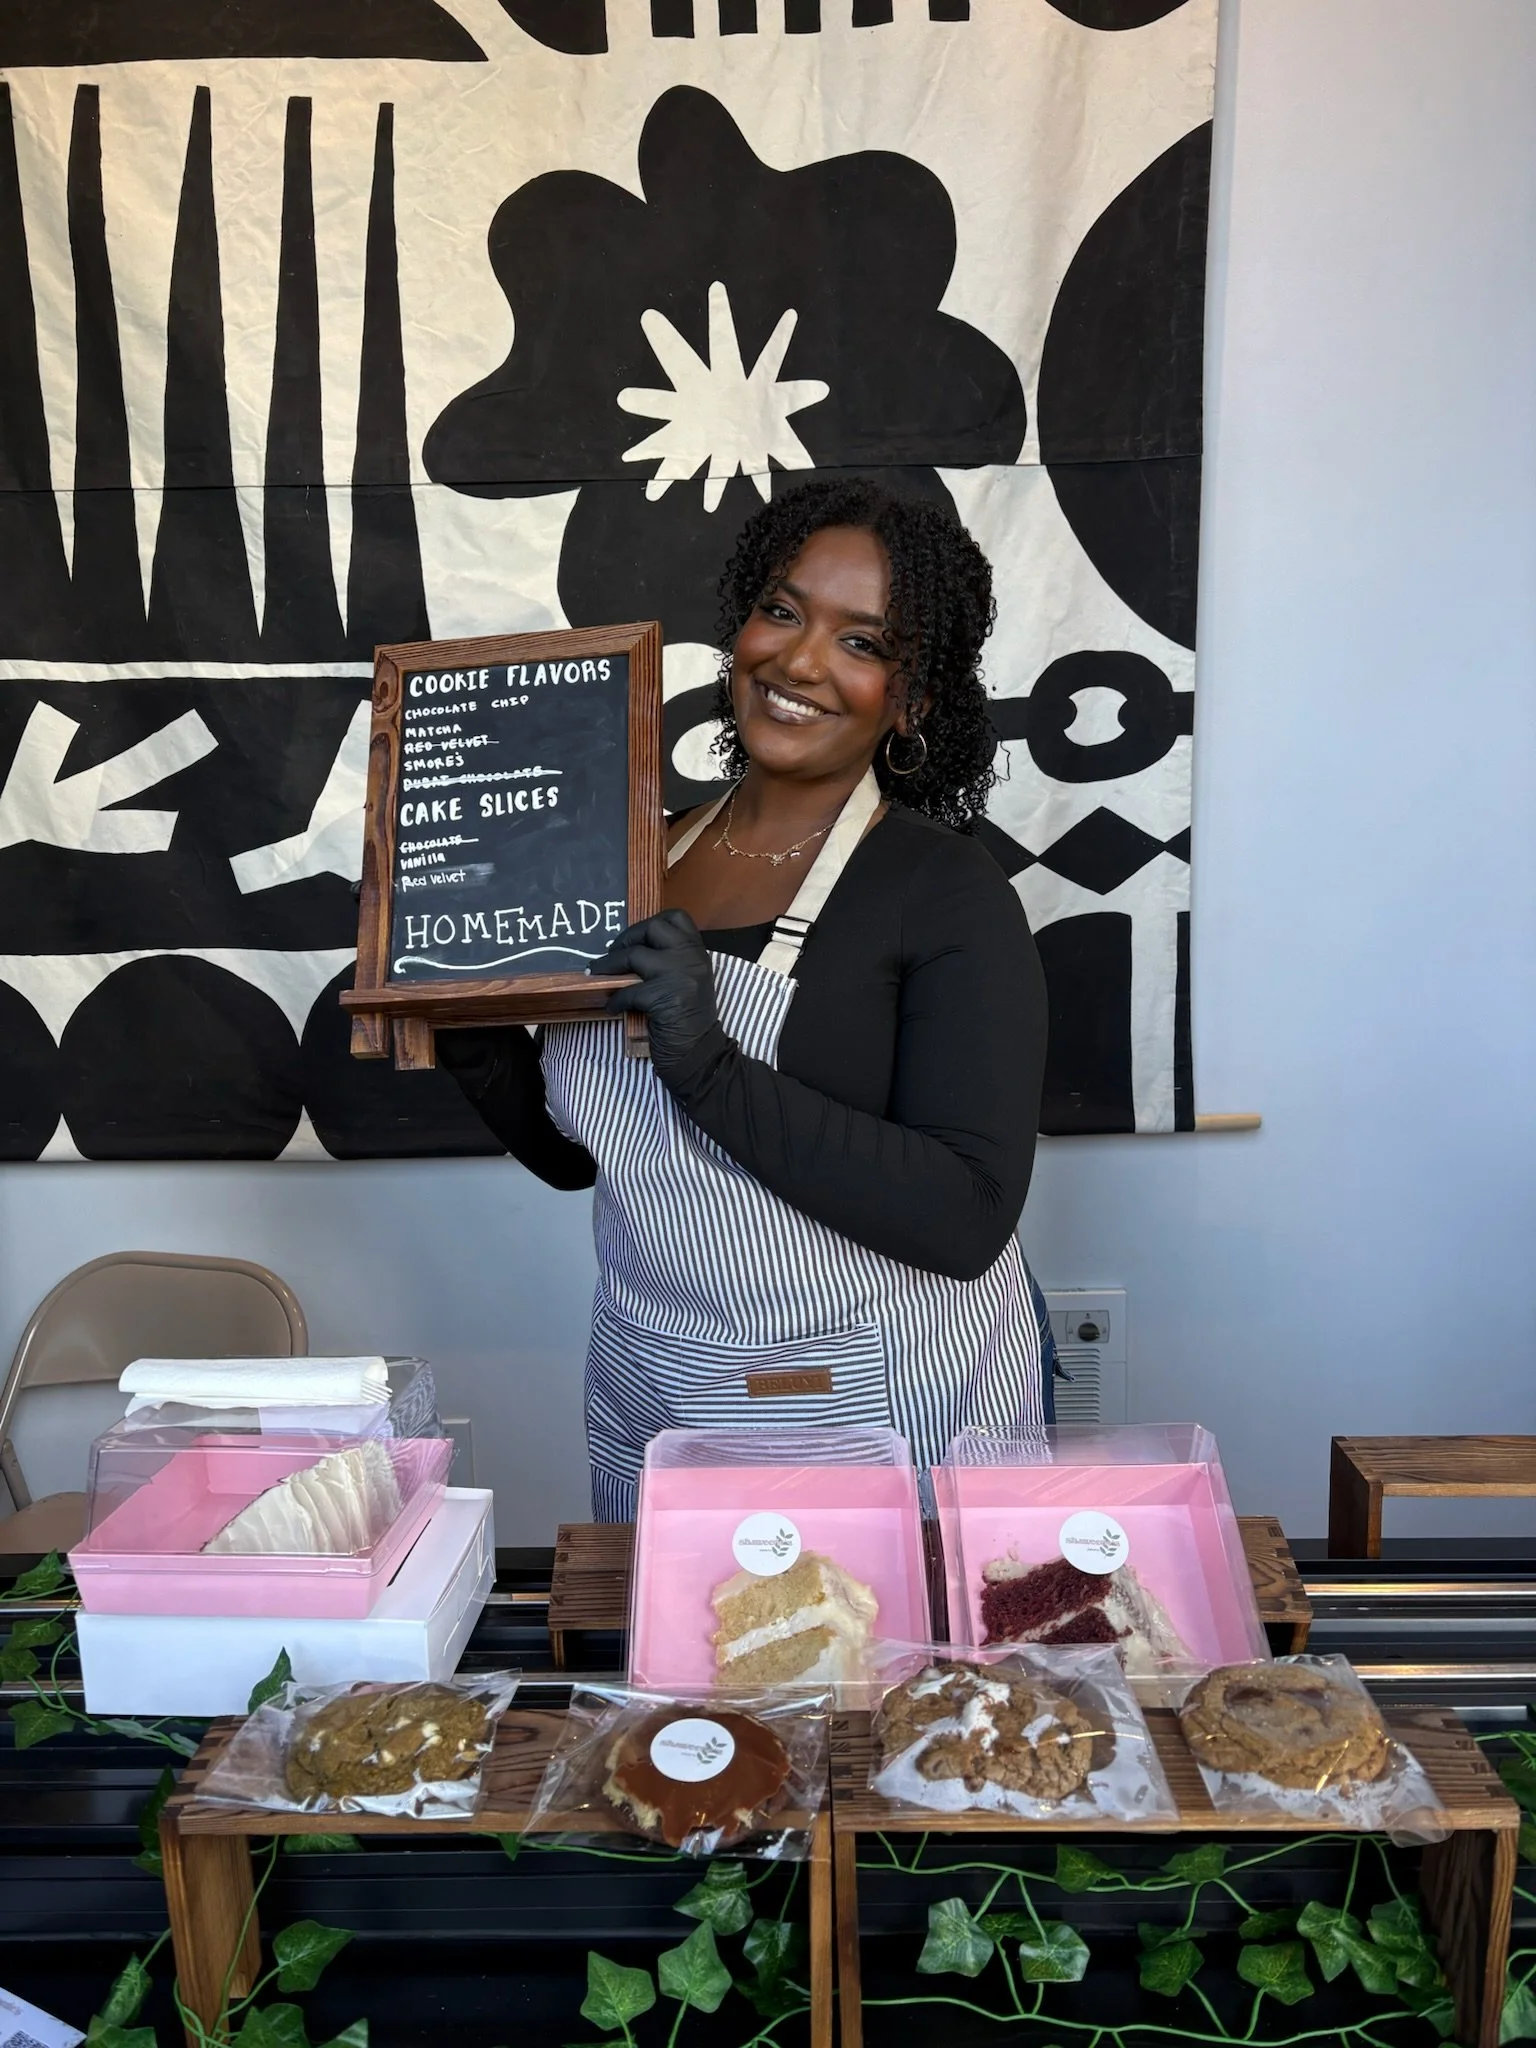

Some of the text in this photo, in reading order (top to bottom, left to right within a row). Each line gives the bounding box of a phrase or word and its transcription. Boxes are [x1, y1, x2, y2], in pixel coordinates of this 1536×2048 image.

[409, 659, 611, 697] COOKIE FLAVORS
[405, 695, 529, 720] CHOCOLATE CHIP
[405, 724, 462, 738] MATCHA
[400, 786, 559, 827] CAKE SLICES
[404, 899, 625, 948] HOMEMADE
